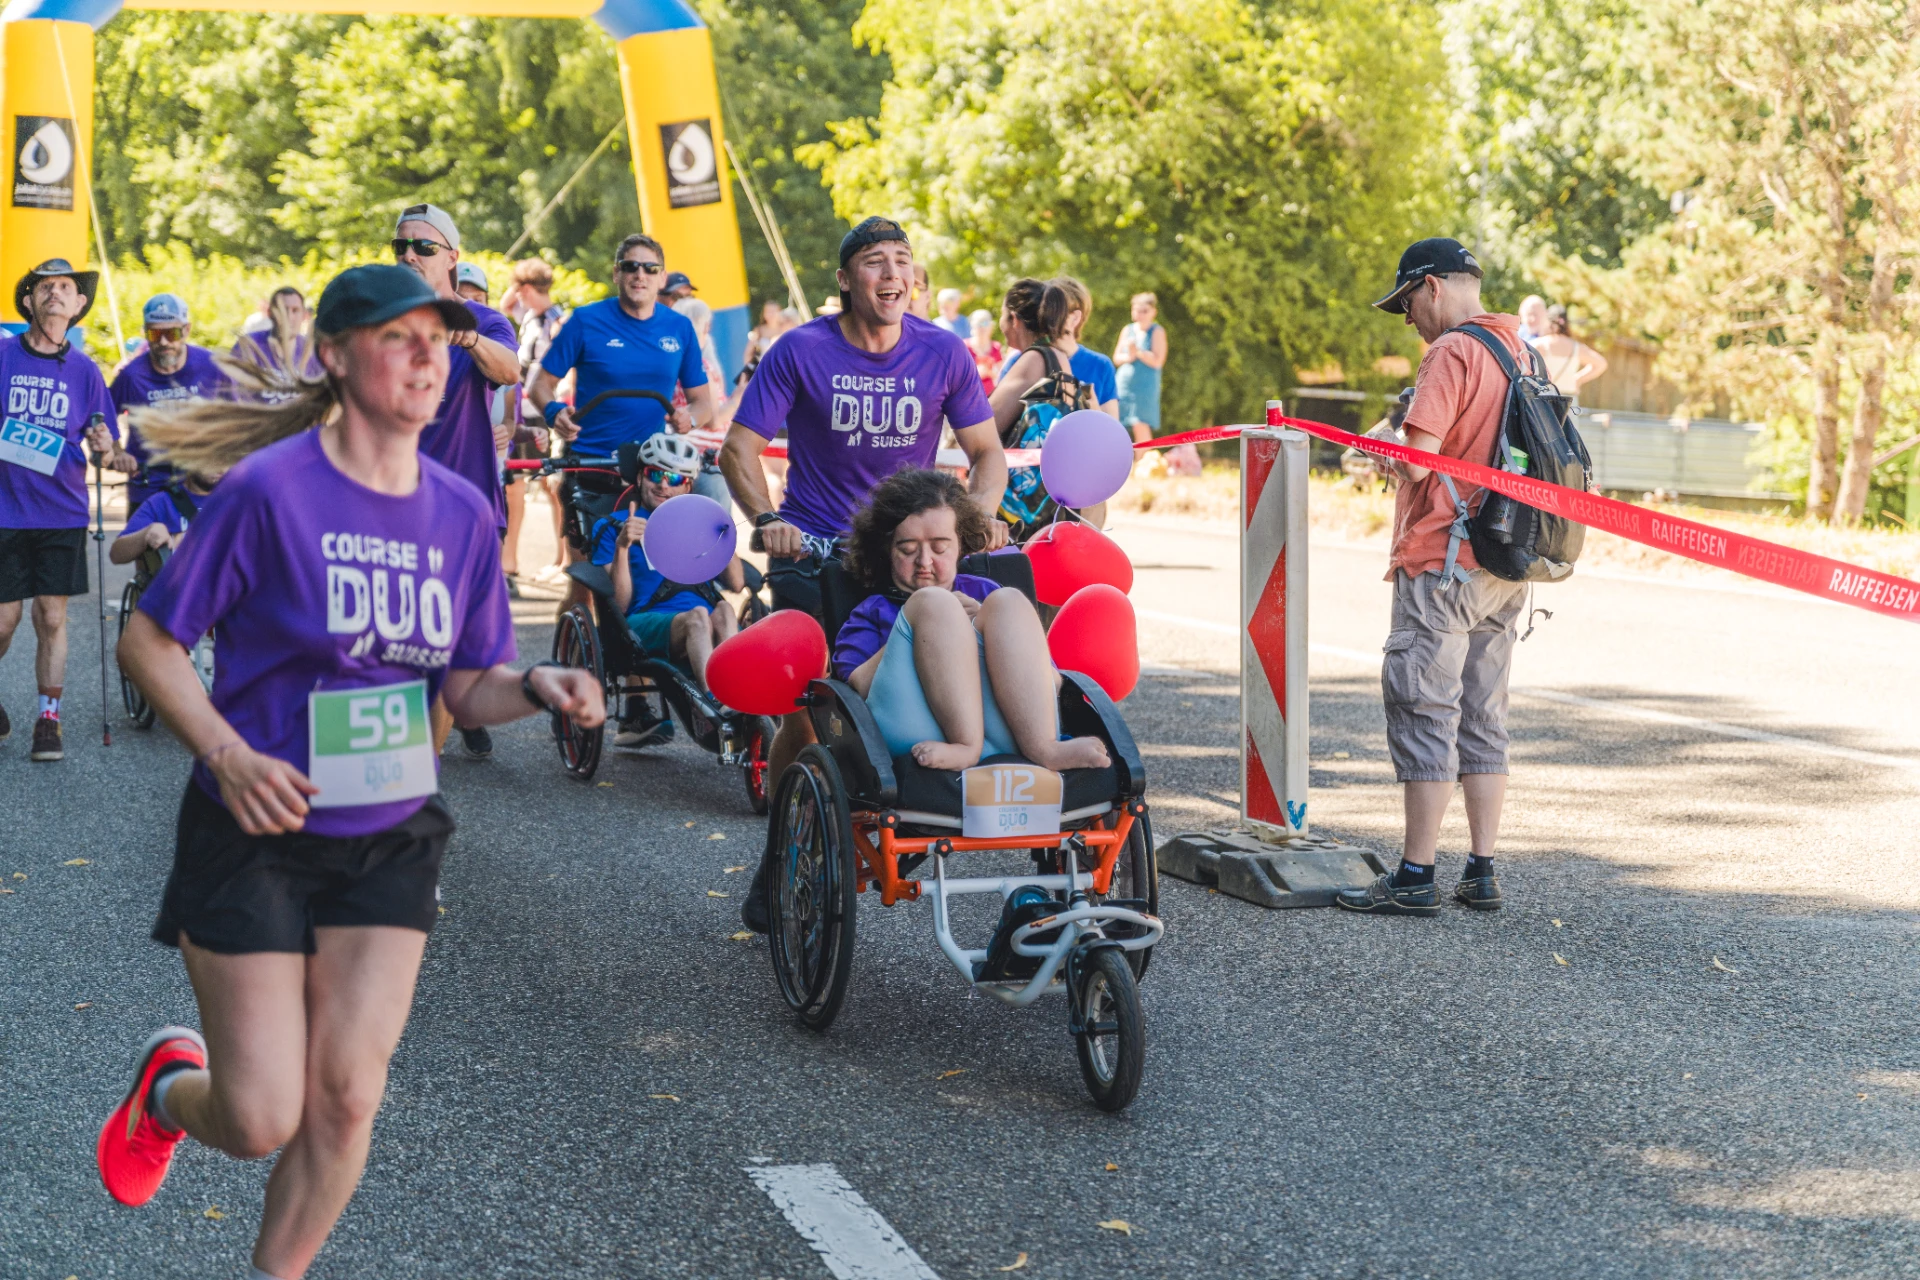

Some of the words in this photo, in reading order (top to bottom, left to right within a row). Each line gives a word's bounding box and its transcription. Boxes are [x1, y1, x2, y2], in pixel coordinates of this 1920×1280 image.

[11, 375, 55, 390] COURSE
[147, 386, 188, 401] COURSE
[832, 374, 896, 393] COURSE
[8, 387, 69, 419] DUO
[831, 393, 922, 435] DUO
[9, 423, 57, 452] 207
[34, 416, 67, 430] SUISSE
[871, 434, 918, 448] SUISSE
[321, 532, 418, 571] COURSE
[1651, 518, 1728, 559] RAIFFEISEN
[1828, 568, 1920, 612] RAIFFEISEN
[327, 565, 452, 648] DUO
[348, 692, 409, 750] 59
[992, 769, 1035, 803] 112
[998, 812, 1028, 827] DUO
